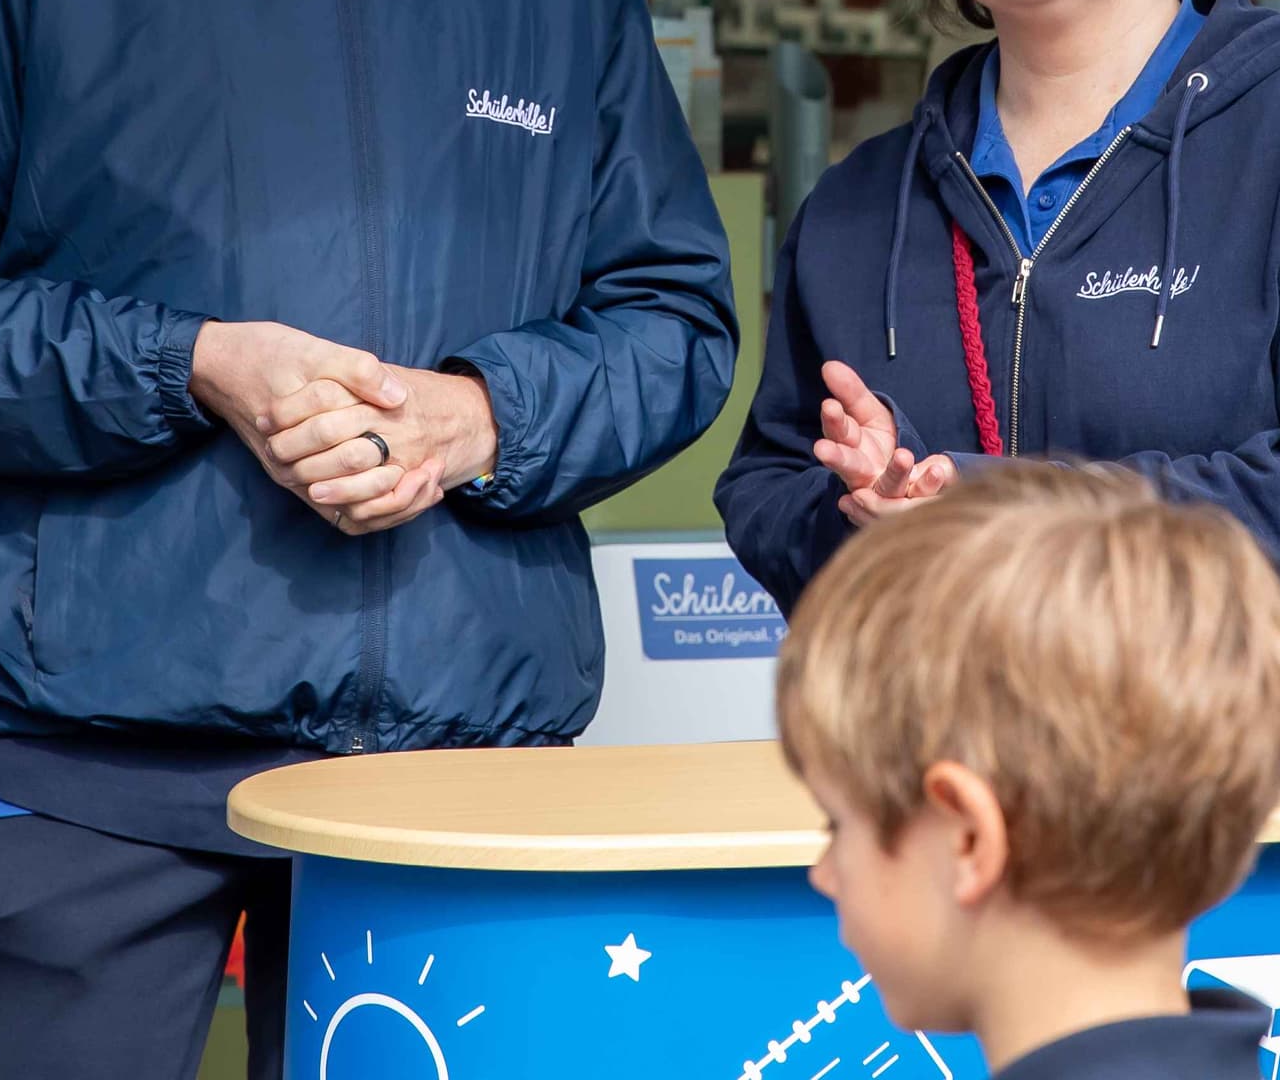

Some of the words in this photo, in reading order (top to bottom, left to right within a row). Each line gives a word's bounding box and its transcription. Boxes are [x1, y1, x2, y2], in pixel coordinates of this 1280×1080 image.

[466, 88, 556, 136] Schülerhilfe!
[1077, 264, 1200, 299] Schülerhfe!
[651, 572, 780, 616] Schüler
[674, 629, 702, 645] Das
[706, 626, 773, 647] Original.
